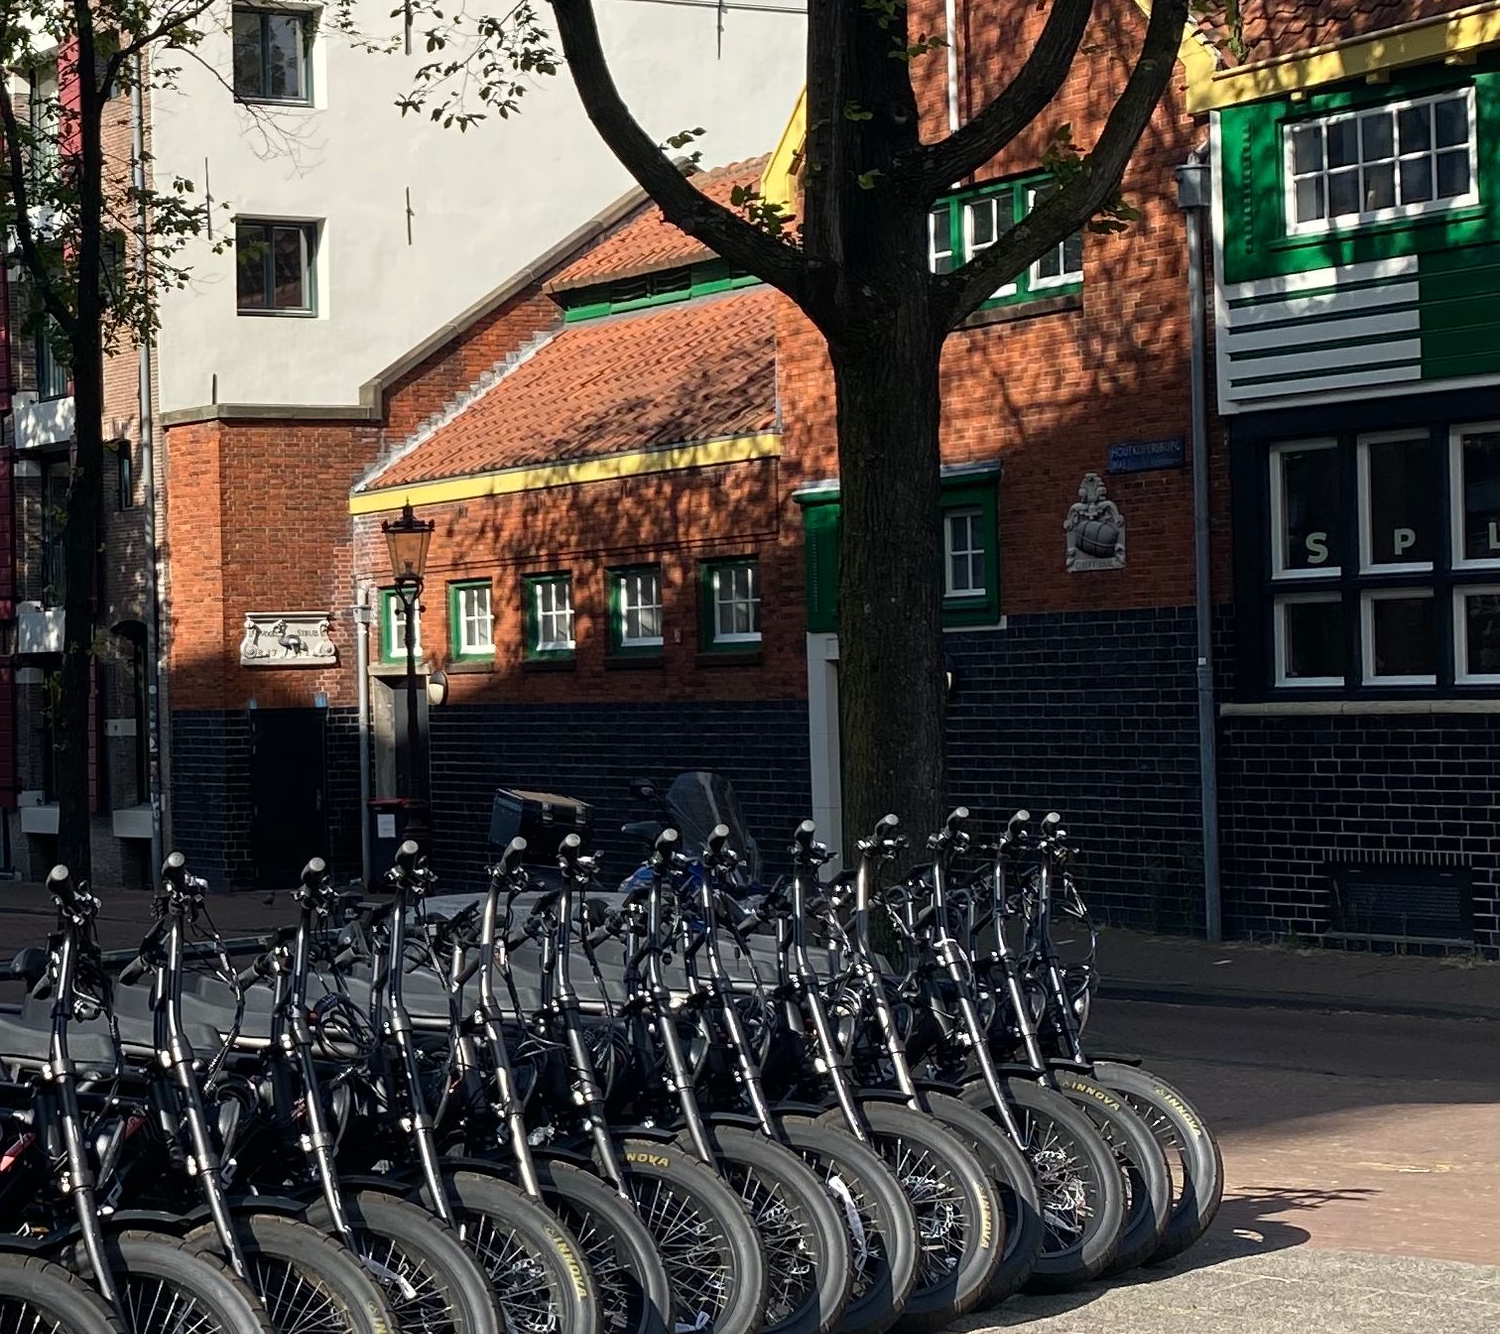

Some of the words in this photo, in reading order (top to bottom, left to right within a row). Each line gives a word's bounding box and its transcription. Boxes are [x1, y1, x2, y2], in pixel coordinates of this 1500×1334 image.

[1071, 1082, 1121, 1112] INNOVA
[1164, 1094, 1202, 1140] INNOVA
[553, 1236, 587, 1298] INNOVA
